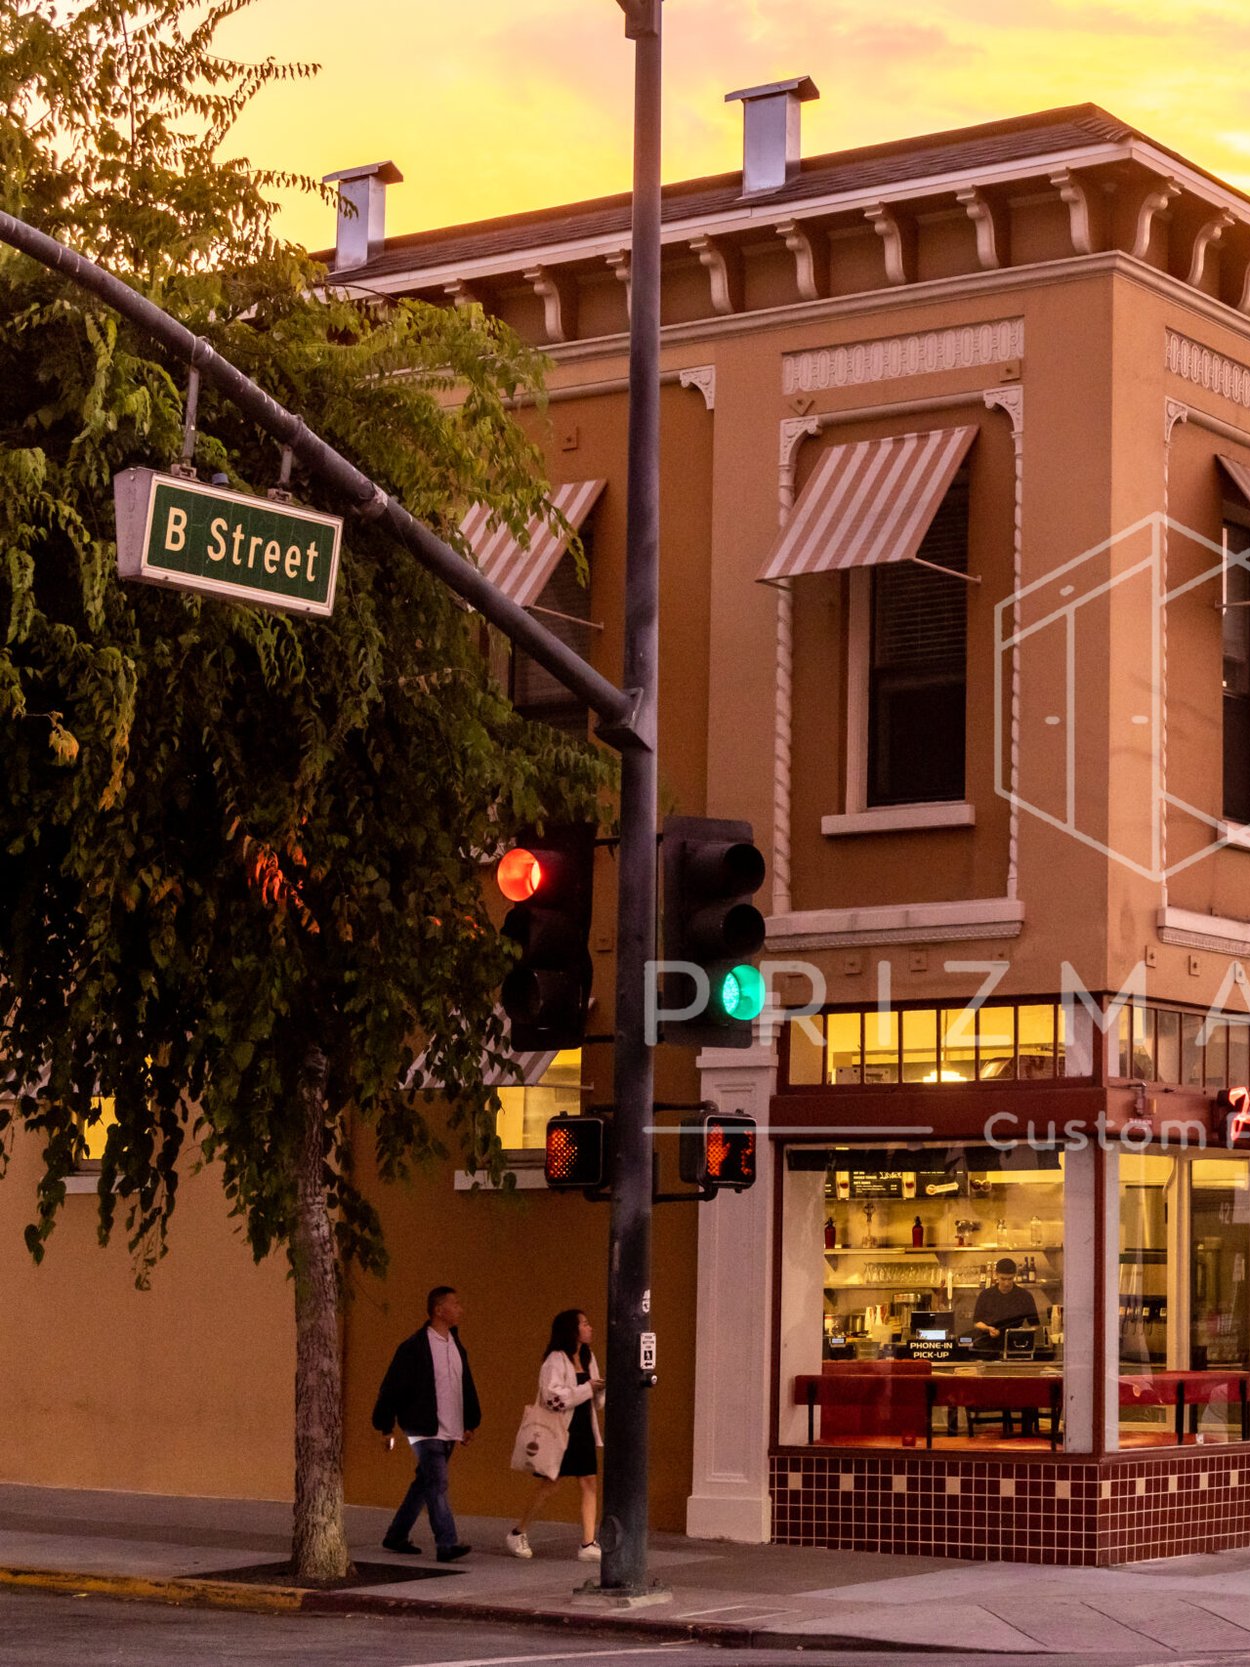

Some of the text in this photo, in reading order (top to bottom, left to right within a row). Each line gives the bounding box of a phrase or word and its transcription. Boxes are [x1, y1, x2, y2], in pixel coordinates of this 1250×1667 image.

[164, 506, 188, 551] B
[207, 517, 319, 582] Street
[913, 1351, 950, 1359] PICK-UP
